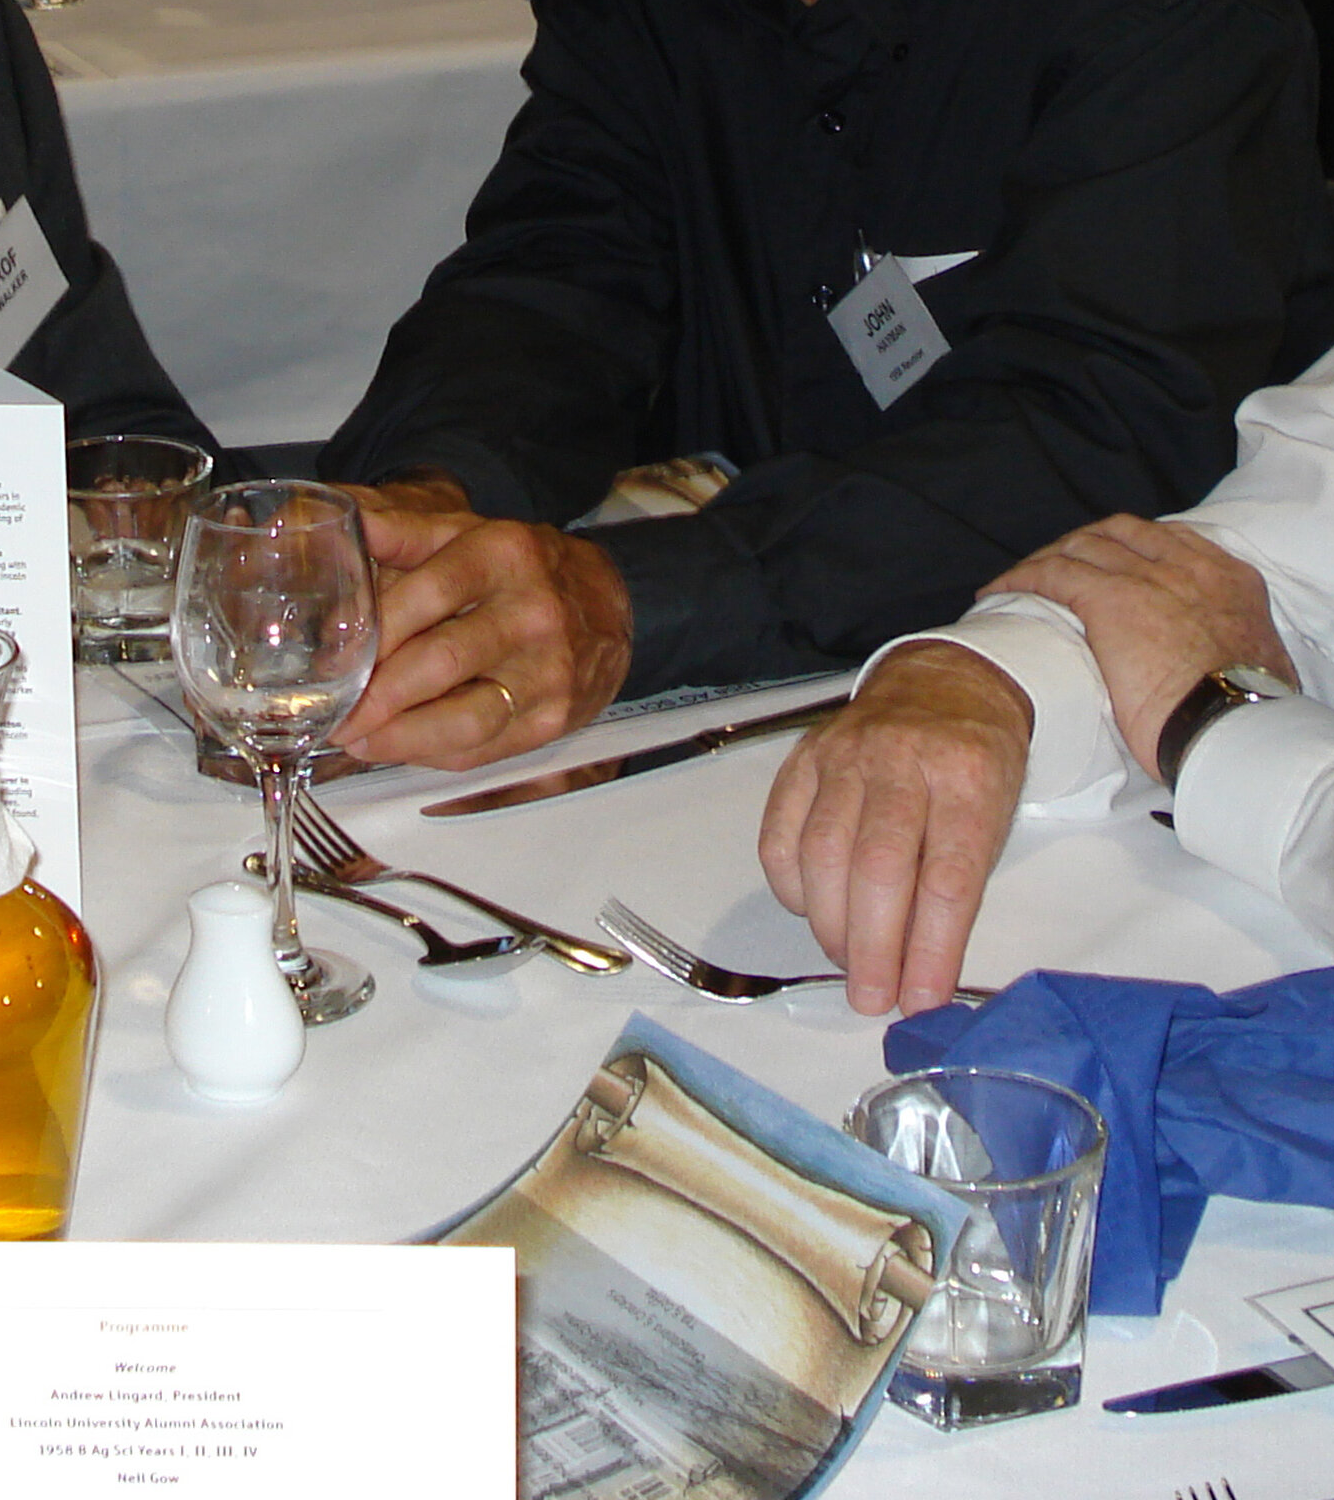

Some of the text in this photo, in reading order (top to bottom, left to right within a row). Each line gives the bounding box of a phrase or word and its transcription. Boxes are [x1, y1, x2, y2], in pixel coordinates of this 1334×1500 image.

[862, 297, 897, 338] JOHN
[100, 1320, 189, 1336] Programme
[115, 1362, 177, 1374] Welcome
[50, 1389, 104, 1401] Andrew
[173, 1390, 241, 1402] President
[10, 1417, 284, 1432] Lincoln University Alumni Association
[92, 1445, 109, 1459] Ag
[138, 1445, 175, 1457] Years
[243, 1446, 258, 1457] IV
[150, 1472, 180, 1485] Gow
